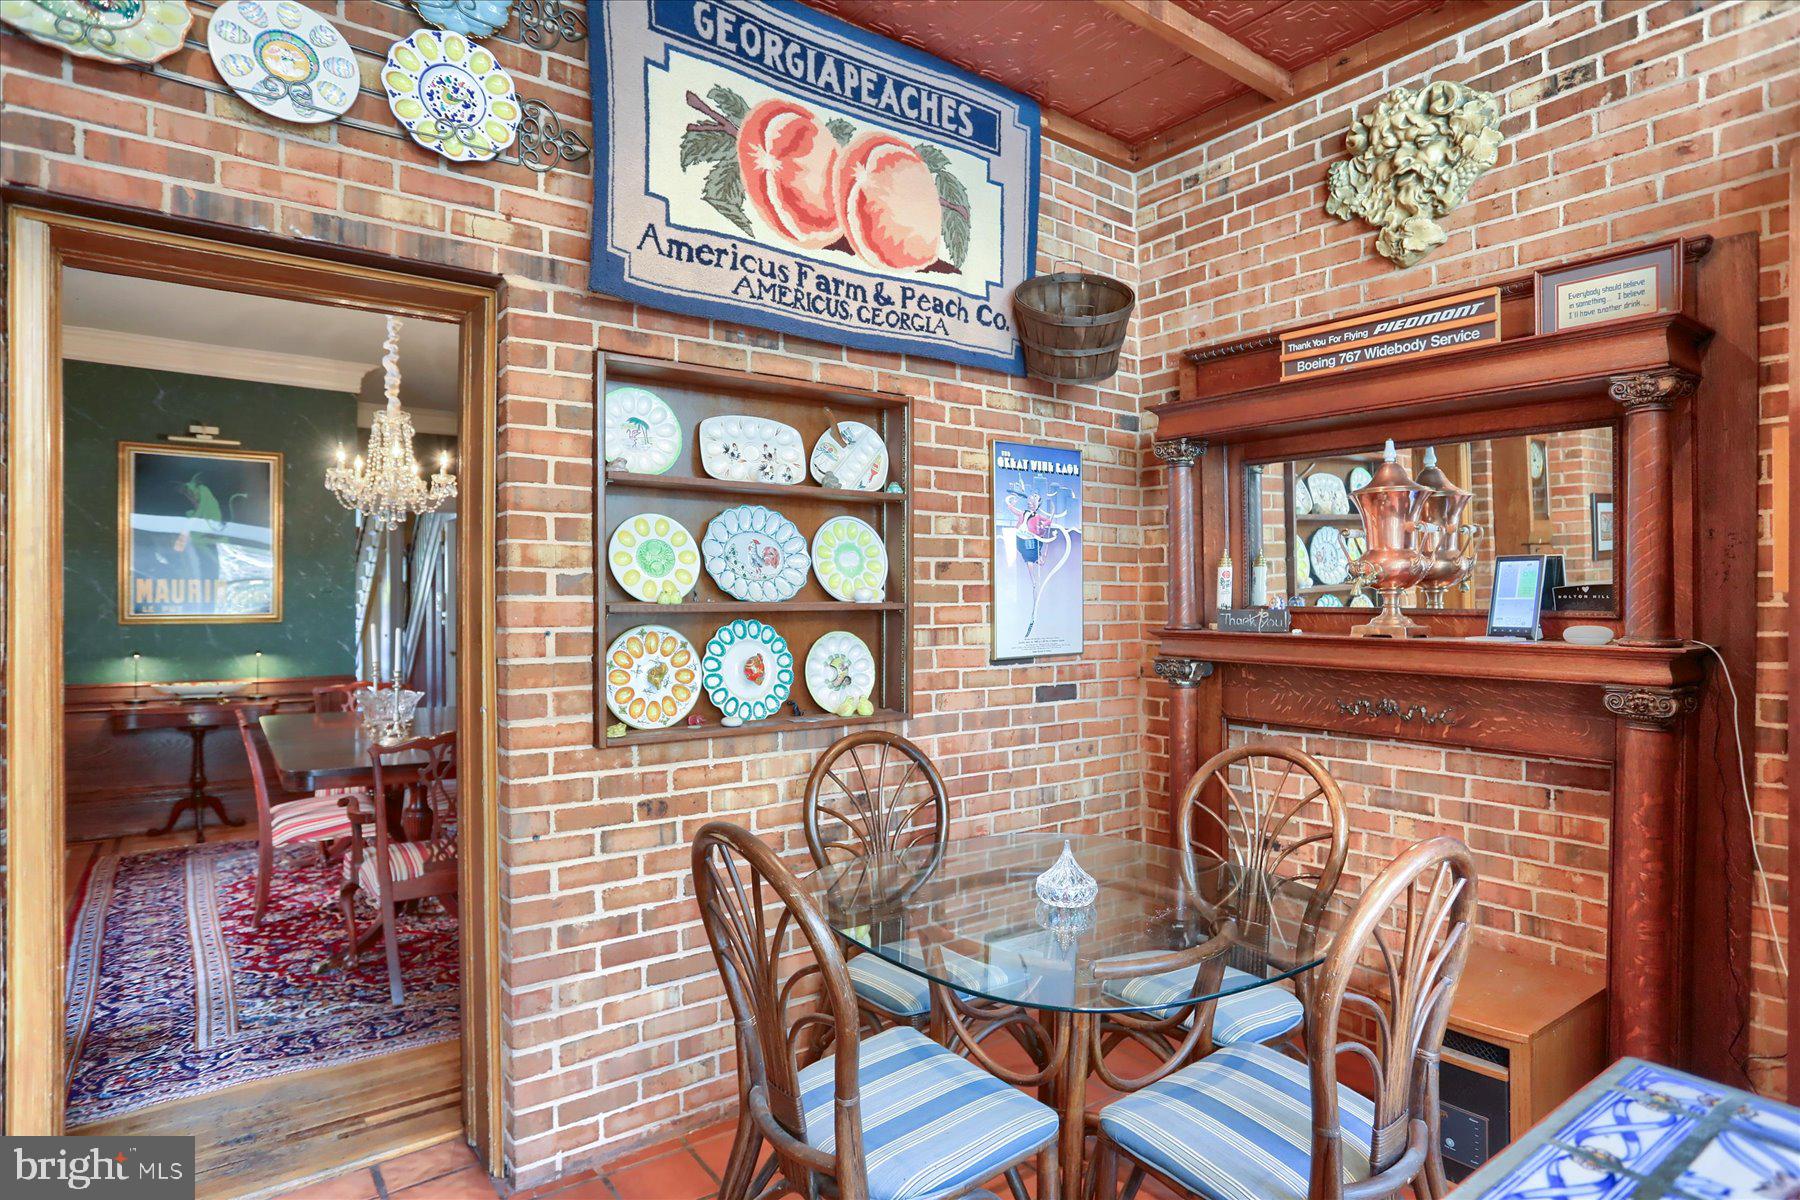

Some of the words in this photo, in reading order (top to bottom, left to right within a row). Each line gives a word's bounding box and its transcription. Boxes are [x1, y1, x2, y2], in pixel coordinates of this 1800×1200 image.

[637, 223, 789, 283] Americus
[795, 260, 867, 303] Farm
[872, 282, 895, 307] &
[900, 286, 968, 323] Peach
[976, 304, 1010, 331] Co.
[1568, 287, 1600, 300] Everybody
[1602, 283, 1621, 293] should
[1623, 279, 1645, 288] believe
[731, 275, 853, 322] AMERICUS,
[856, 306, 950, 336] GEORGIA
[1623, 289, 1645, 299] believe
[1580, 309, 1595, 318] have
[1597, 303, 1623, 314] another
[1288, 341, 1311, 353] Thank
[1312, 338, 1326, 348] You
[1328, 335, 1341, 344] For
[1344, 329, 1369, 342] Flying
[1373, 302, 1485, 335] PIEDMONT
[1297, 355, 1336, 373] Boeing
[1338, 350, 1361, 365] 767
[1364, 338, 1427, 360] Widebody
[1430, 329, 1480, 347] Service
[1220, 610, 1256, 626] Thank
